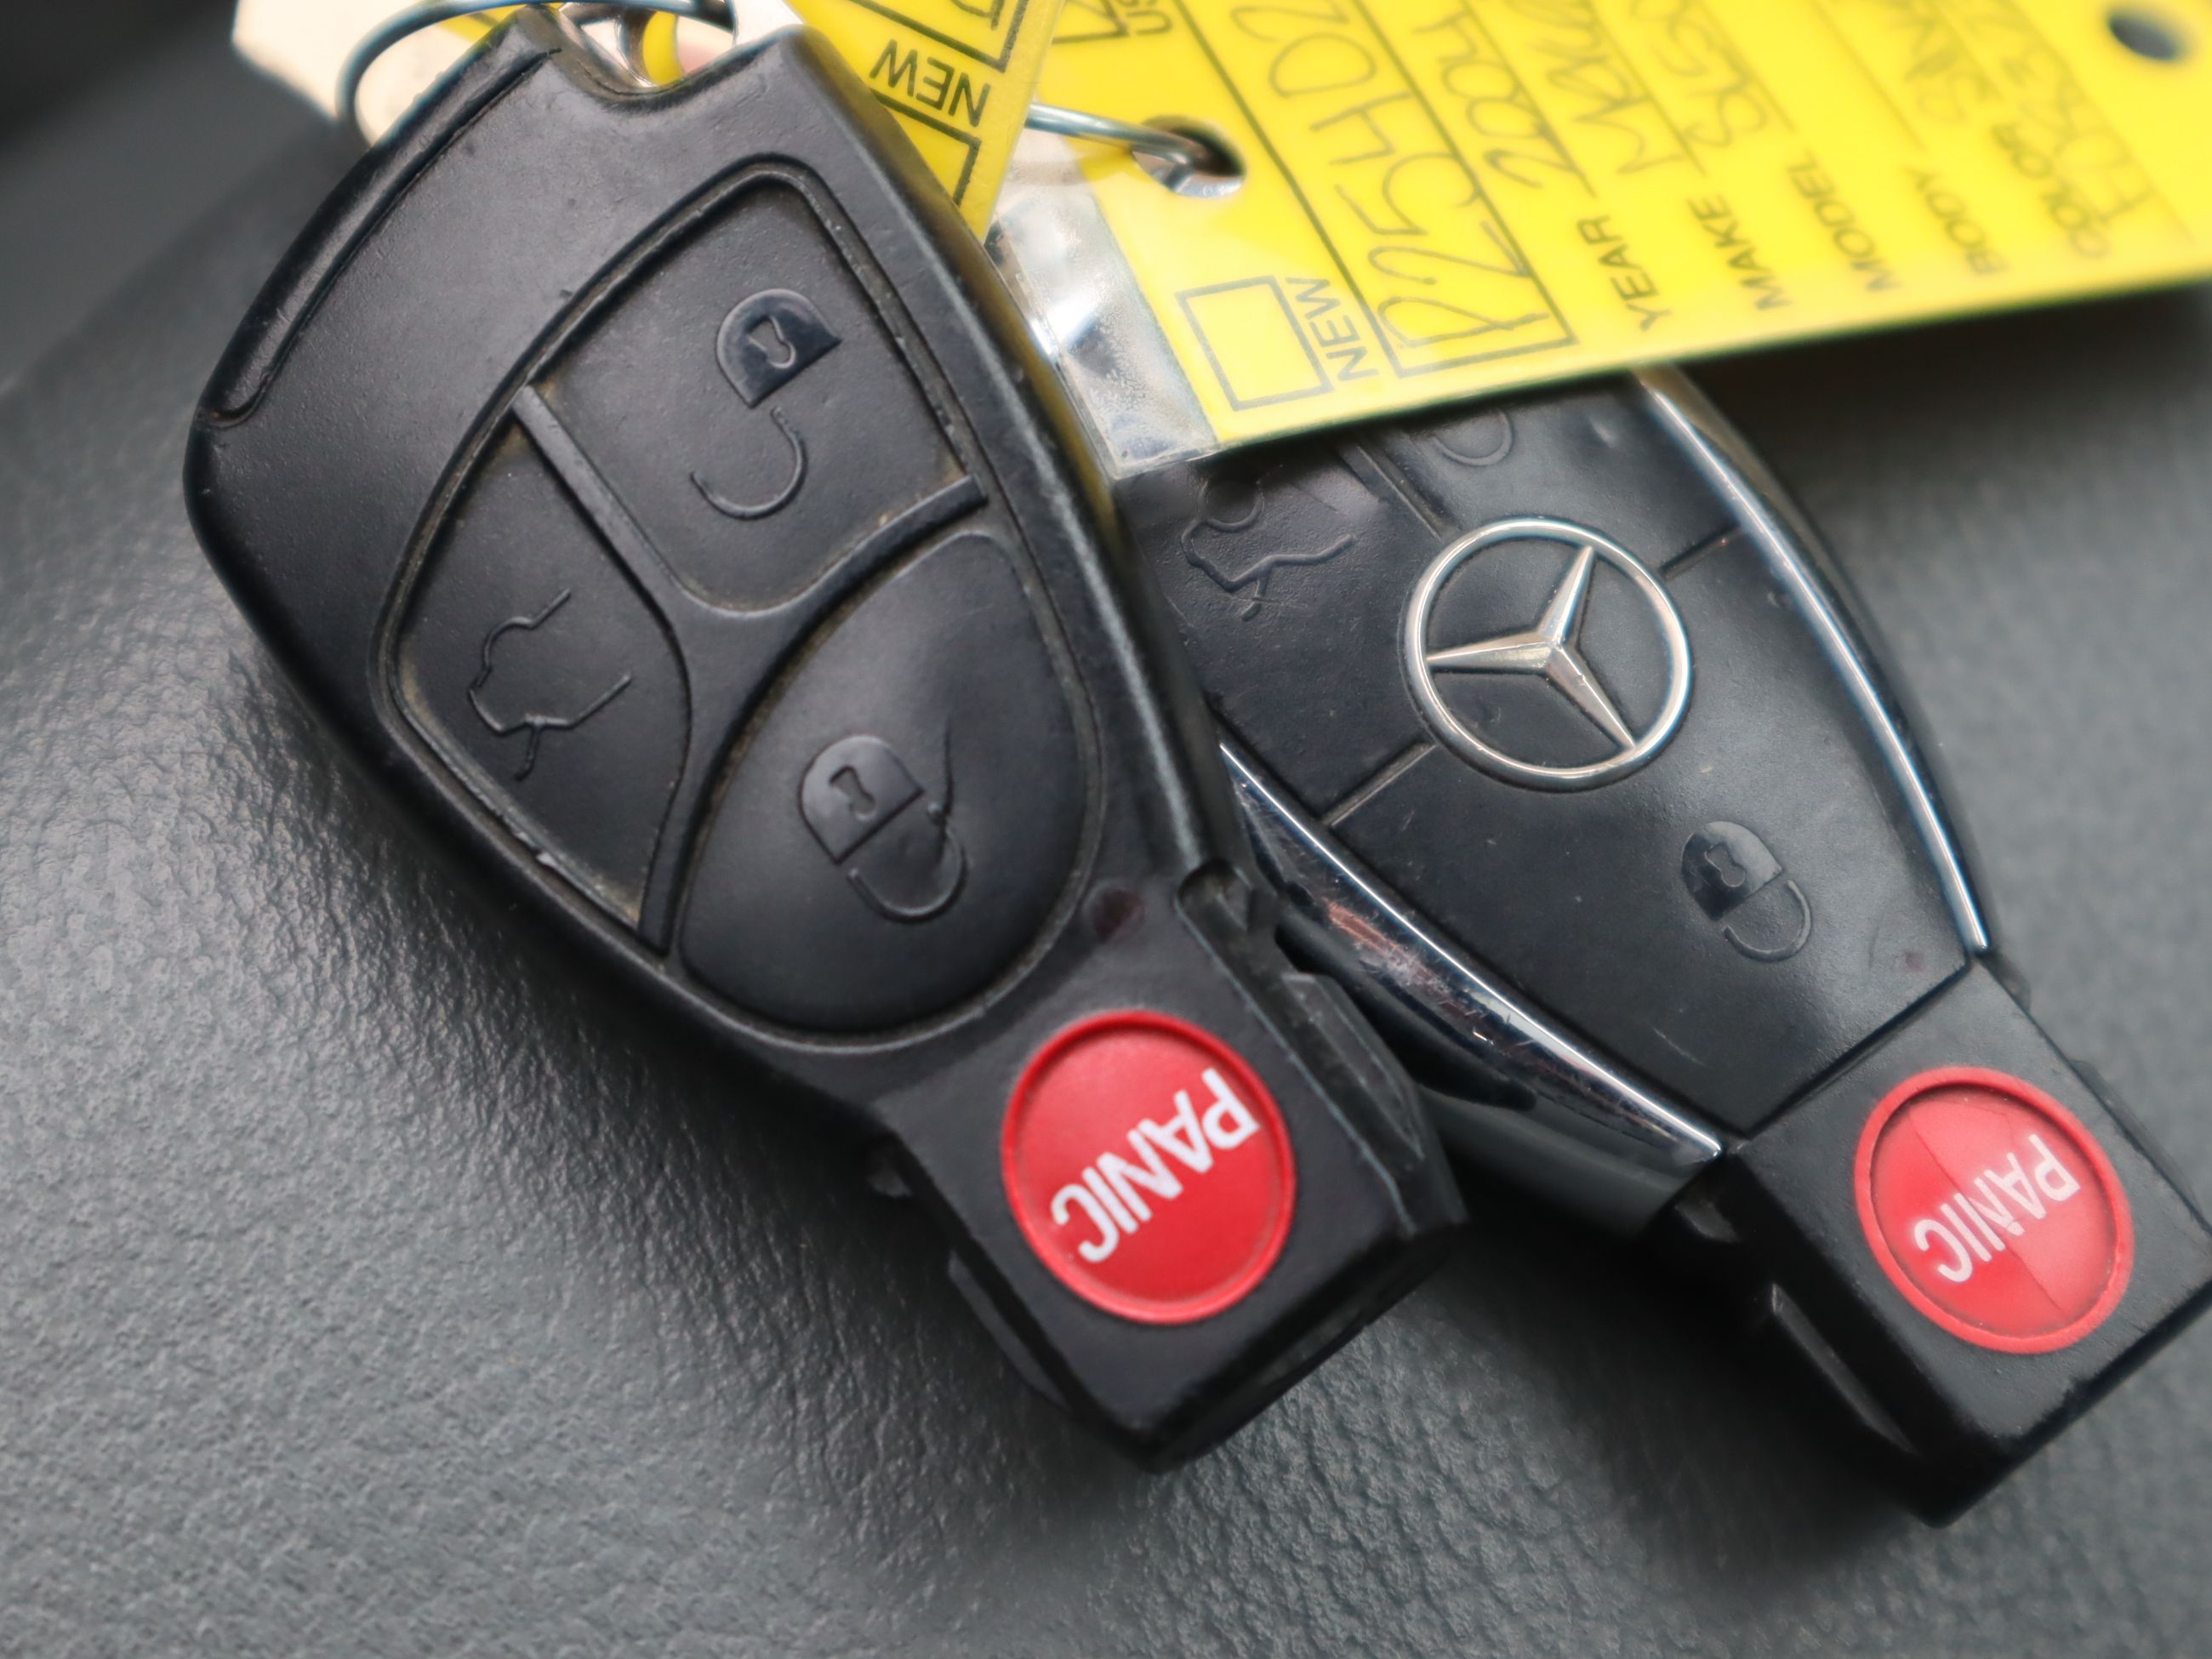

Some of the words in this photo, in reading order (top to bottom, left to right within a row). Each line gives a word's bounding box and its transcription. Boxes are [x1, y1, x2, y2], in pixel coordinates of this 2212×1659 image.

[869, 38, 991, 128] NEW
[1411, 8, 1582, 189] 2004
[1686, 194, 1793, 311] MAKE
[1785, 147, 1905, 295] MODEL
[1904, 162, 2009, 278] BODY
[1991, 123, 2111, 259] COLOR
[1285, 276, 1380, 382] NEW
[1576, 214, 1673, 332] YEAR
[1050, 1068, 1260, 1263] PANIC
[1914, 1133, 2081, 1283] PANIC
